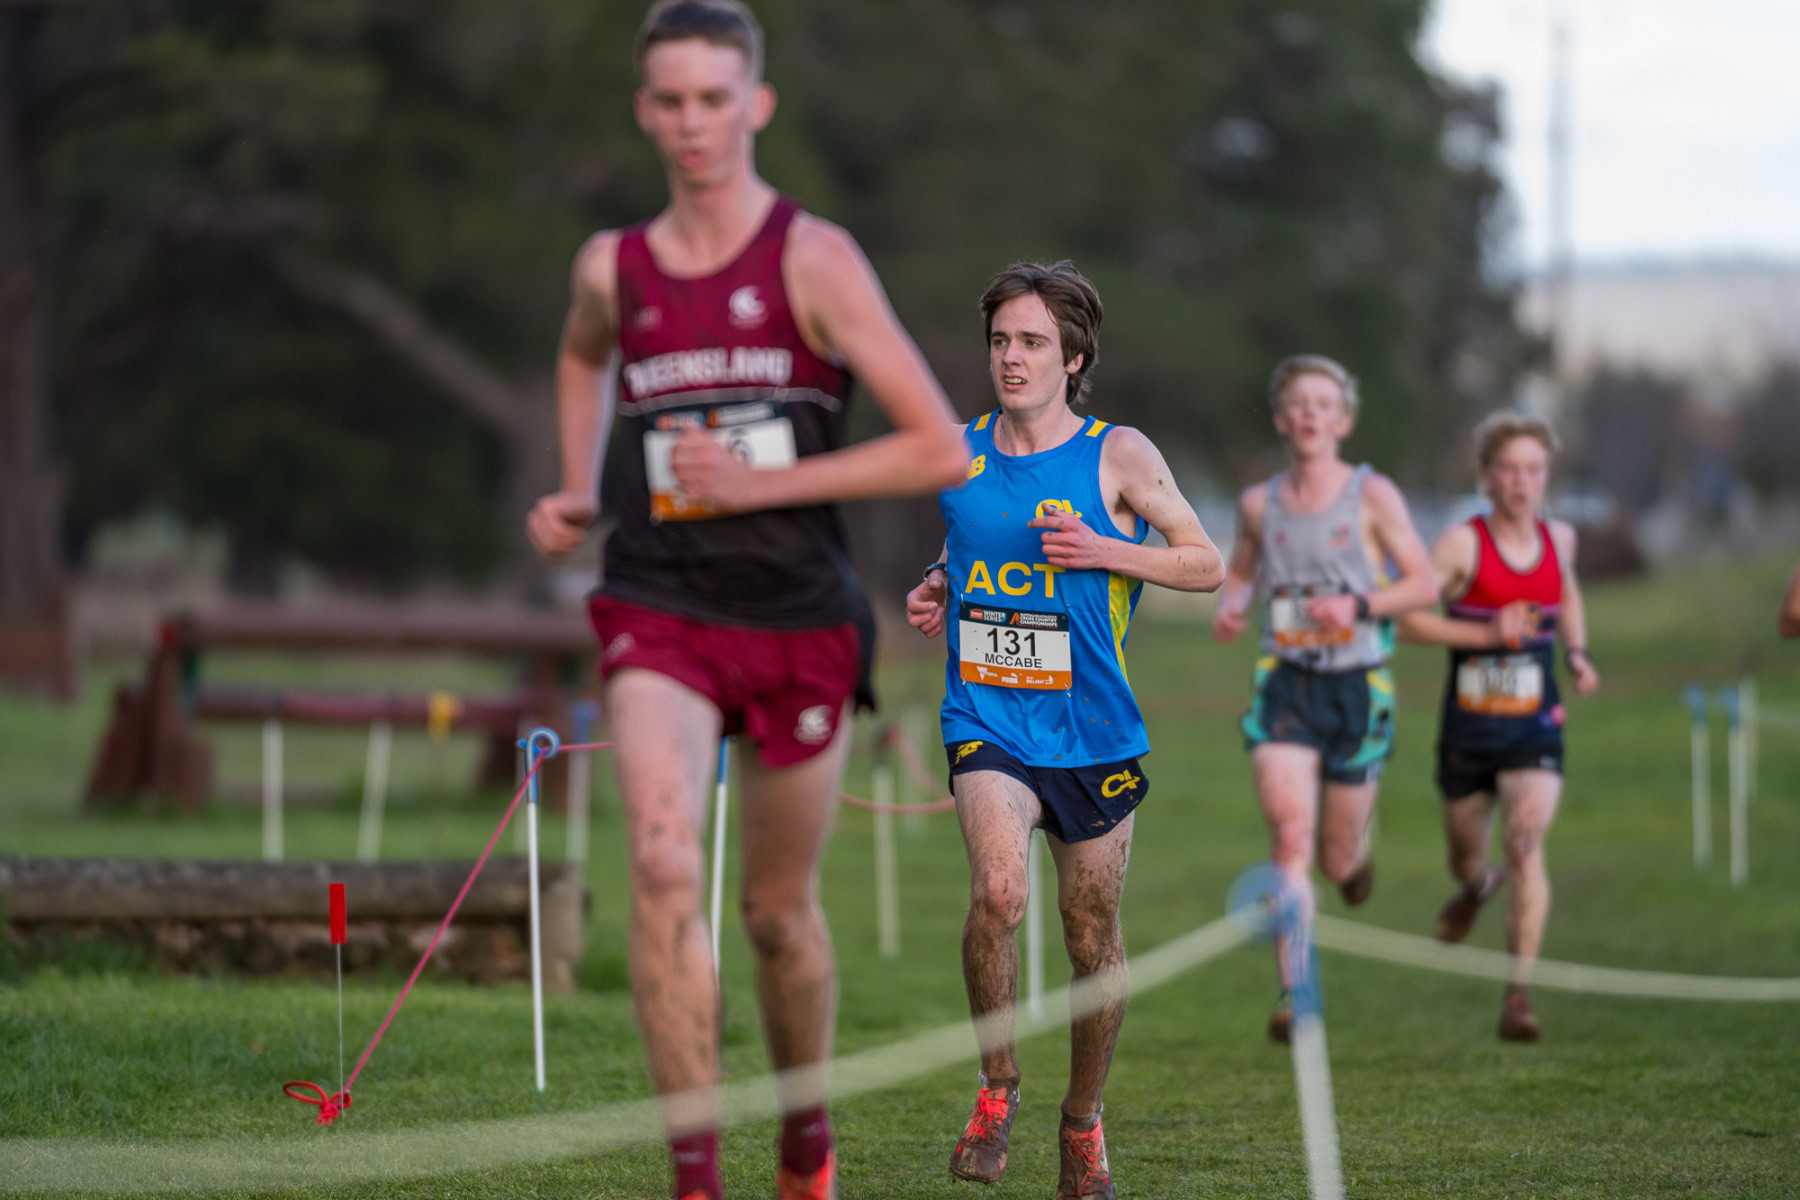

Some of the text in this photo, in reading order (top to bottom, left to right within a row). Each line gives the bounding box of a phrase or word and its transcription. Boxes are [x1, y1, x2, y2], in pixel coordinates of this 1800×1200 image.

[624, 347, 793, 399] QUEENSLAND
[965, 560, 1066, 598] ACT
[987, 627, 1036, 657] 131
[985, 653, 1043, 669] MCCABE
